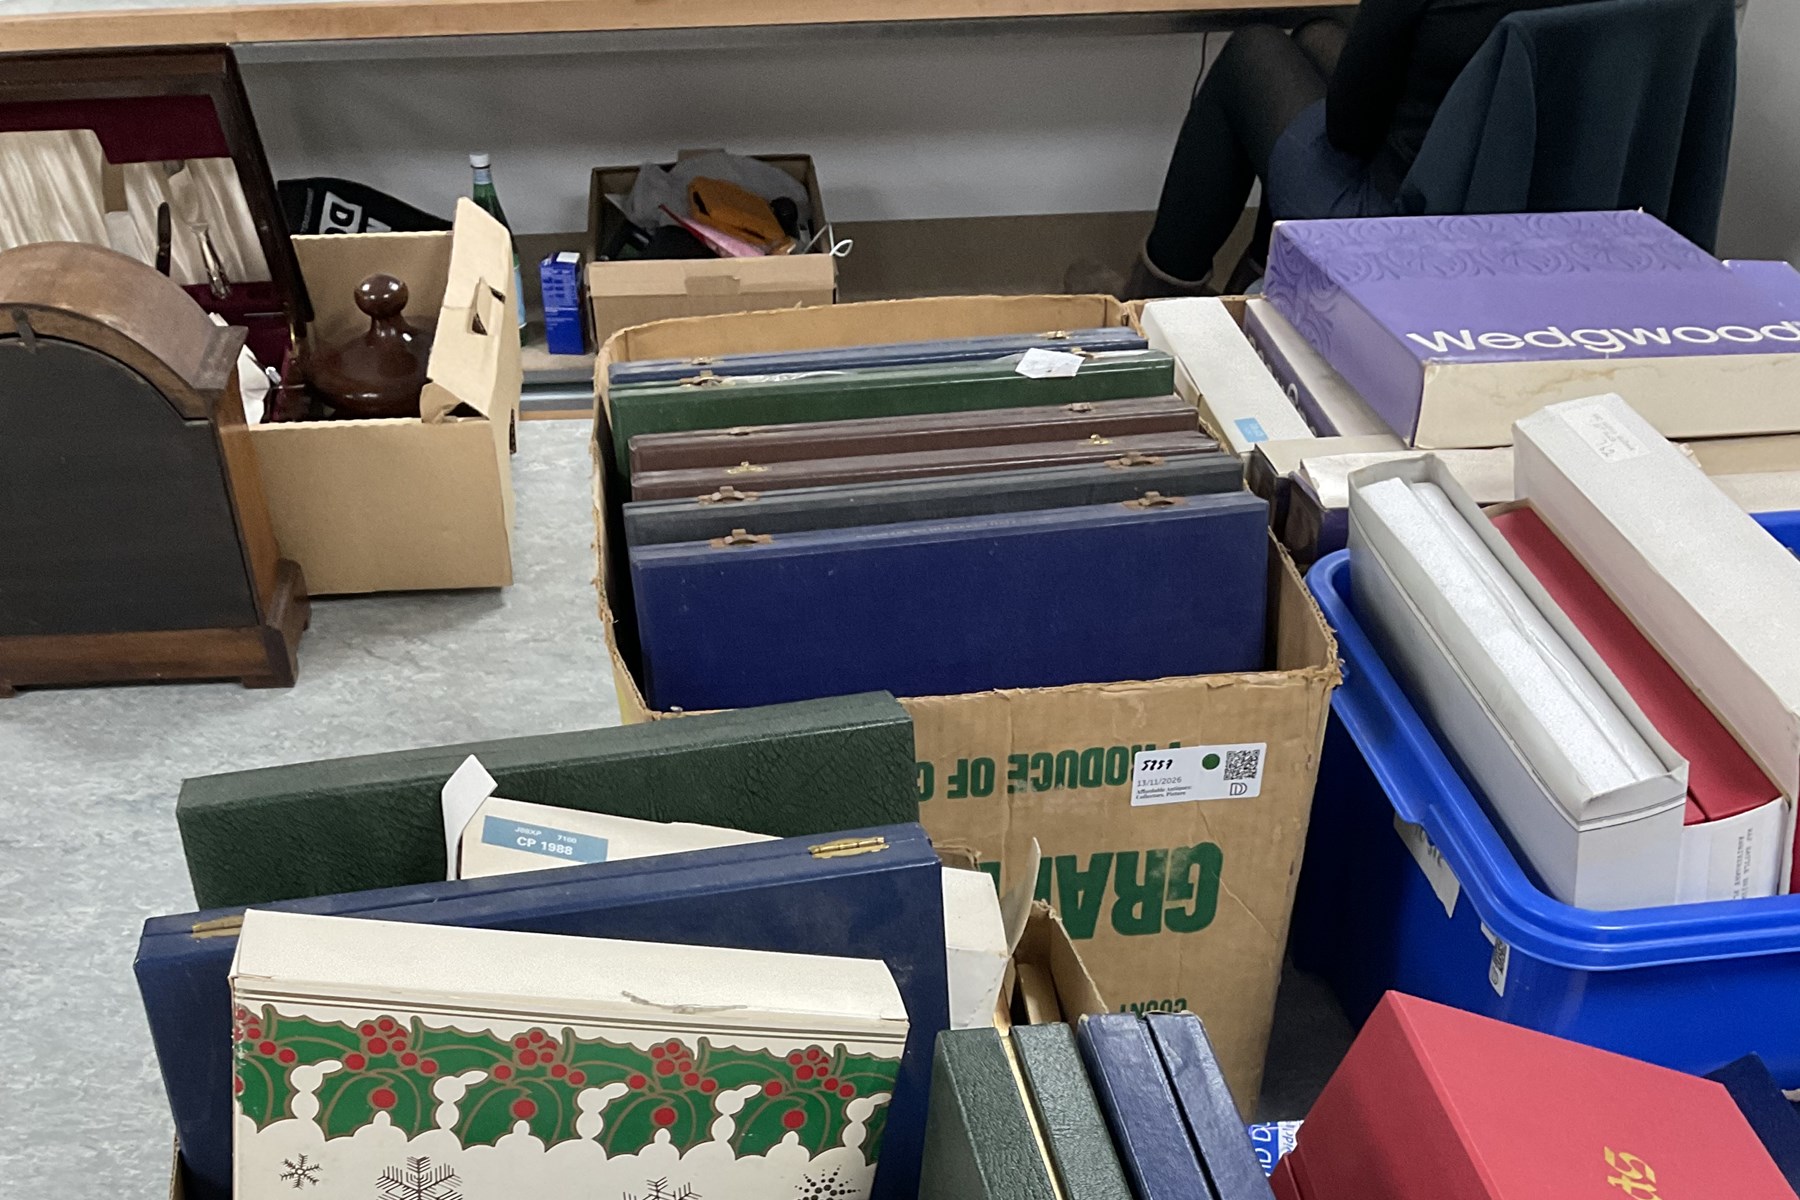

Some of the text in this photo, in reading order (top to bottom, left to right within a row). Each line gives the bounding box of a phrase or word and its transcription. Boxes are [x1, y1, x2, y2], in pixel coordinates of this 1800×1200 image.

[1406, 321, 1800, 353] Wedgwood
[947, 757, 995, 799] OF
[1008, 741, 1181, 794] ODUCE
[1137, 776, 1182, 787] 13/11/2026
[516, 836, 573, 855] CP 1988
